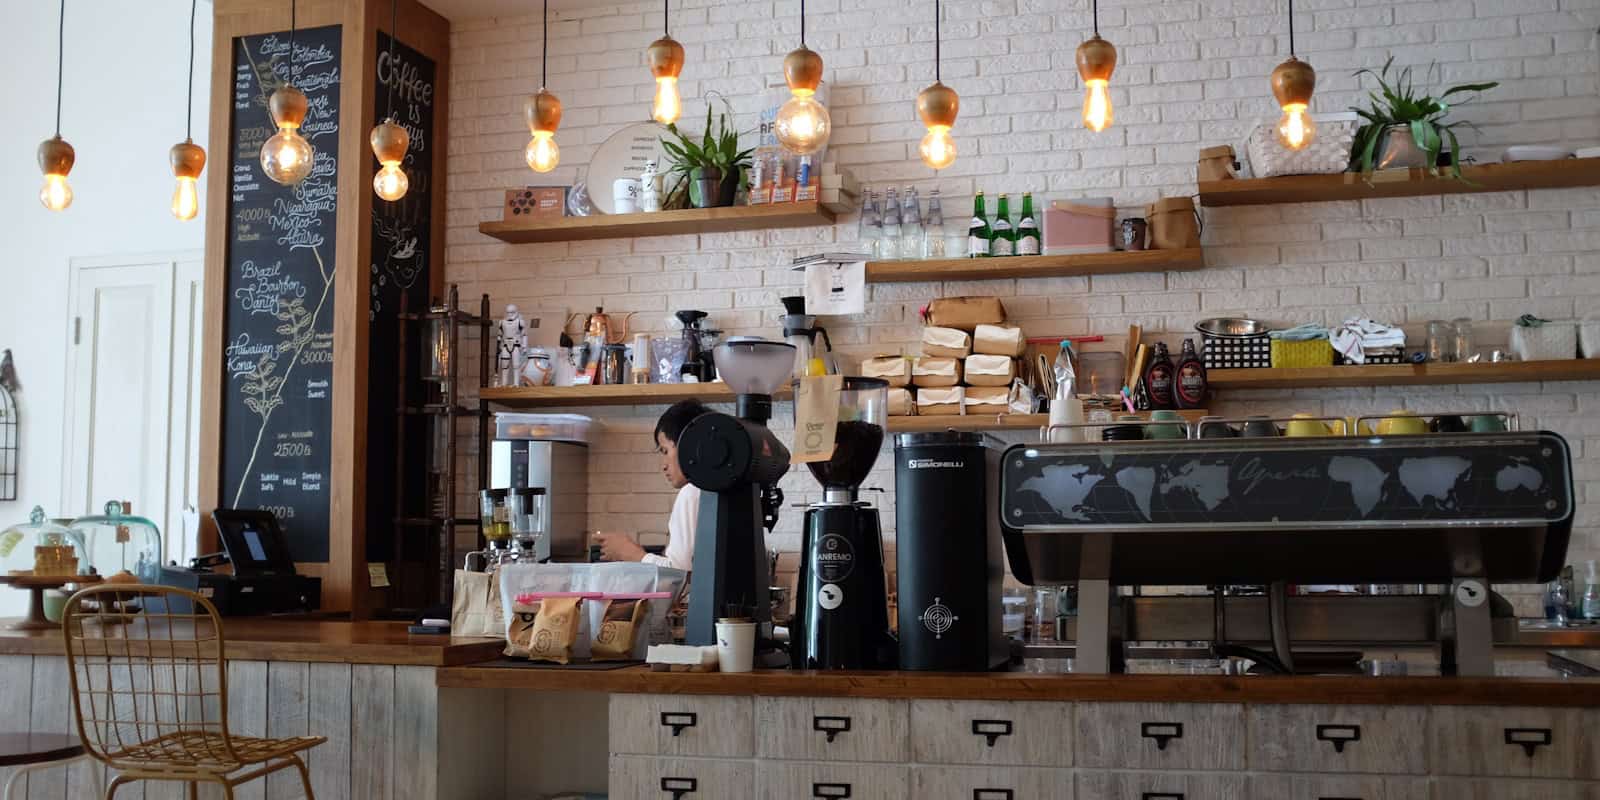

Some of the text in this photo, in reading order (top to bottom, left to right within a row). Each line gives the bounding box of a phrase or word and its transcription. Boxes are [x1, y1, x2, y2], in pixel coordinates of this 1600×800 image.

[291, 44, 334, 67] Colombia
[292, 67, 338, 91] Guatemala
[377, 50, 433, 106] Coffee
[309, 104, 336, 119] New
[408, 103, 421, 124] is
[301, 117, 337, 138] Guinea
[274, 198, 336, 219] Nicaragua
[268, 215, 322, 231] Mexico
[241, 260, 281, 280] Brazil
[255, 275, 306, 298] Bourbon
[235, 284, 280, 316] Santos
[225, 332, 280, 361] Hawaiian
[227, 356, 257, 378] Kona
[301, 351, 327, 365] 3000
[274, 443, 303, 457] 2500
[917, 461, 964, 469] SIMONELLI
[816, 552, 852, 561] ANREMO
